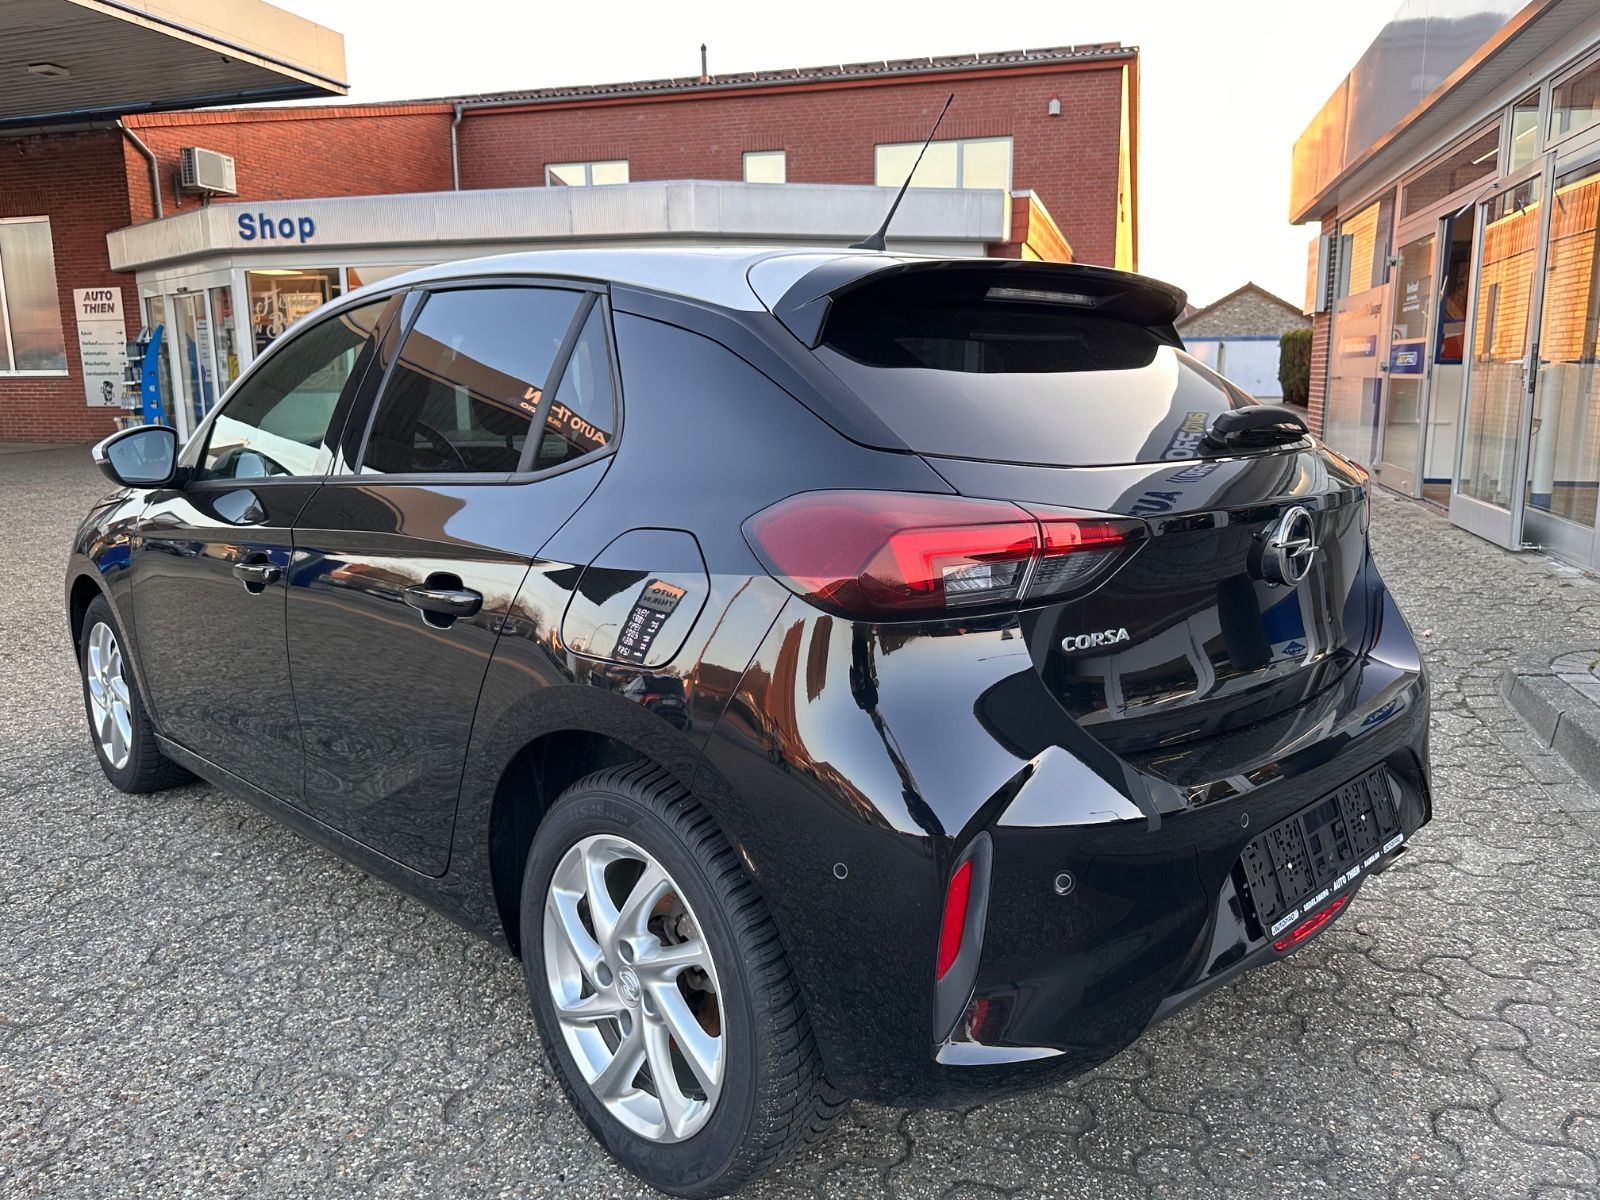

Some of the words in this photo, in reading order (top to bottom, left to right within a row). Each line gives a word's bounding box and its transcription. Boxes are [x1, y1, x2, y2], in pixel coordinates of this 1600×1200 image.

[238, 212, 316, 243] Shop
[83, 290, 113, 302] AUTO
[83, 302, 115, 314] THIEN
[1061, 627, 1130, 652] CORSA
